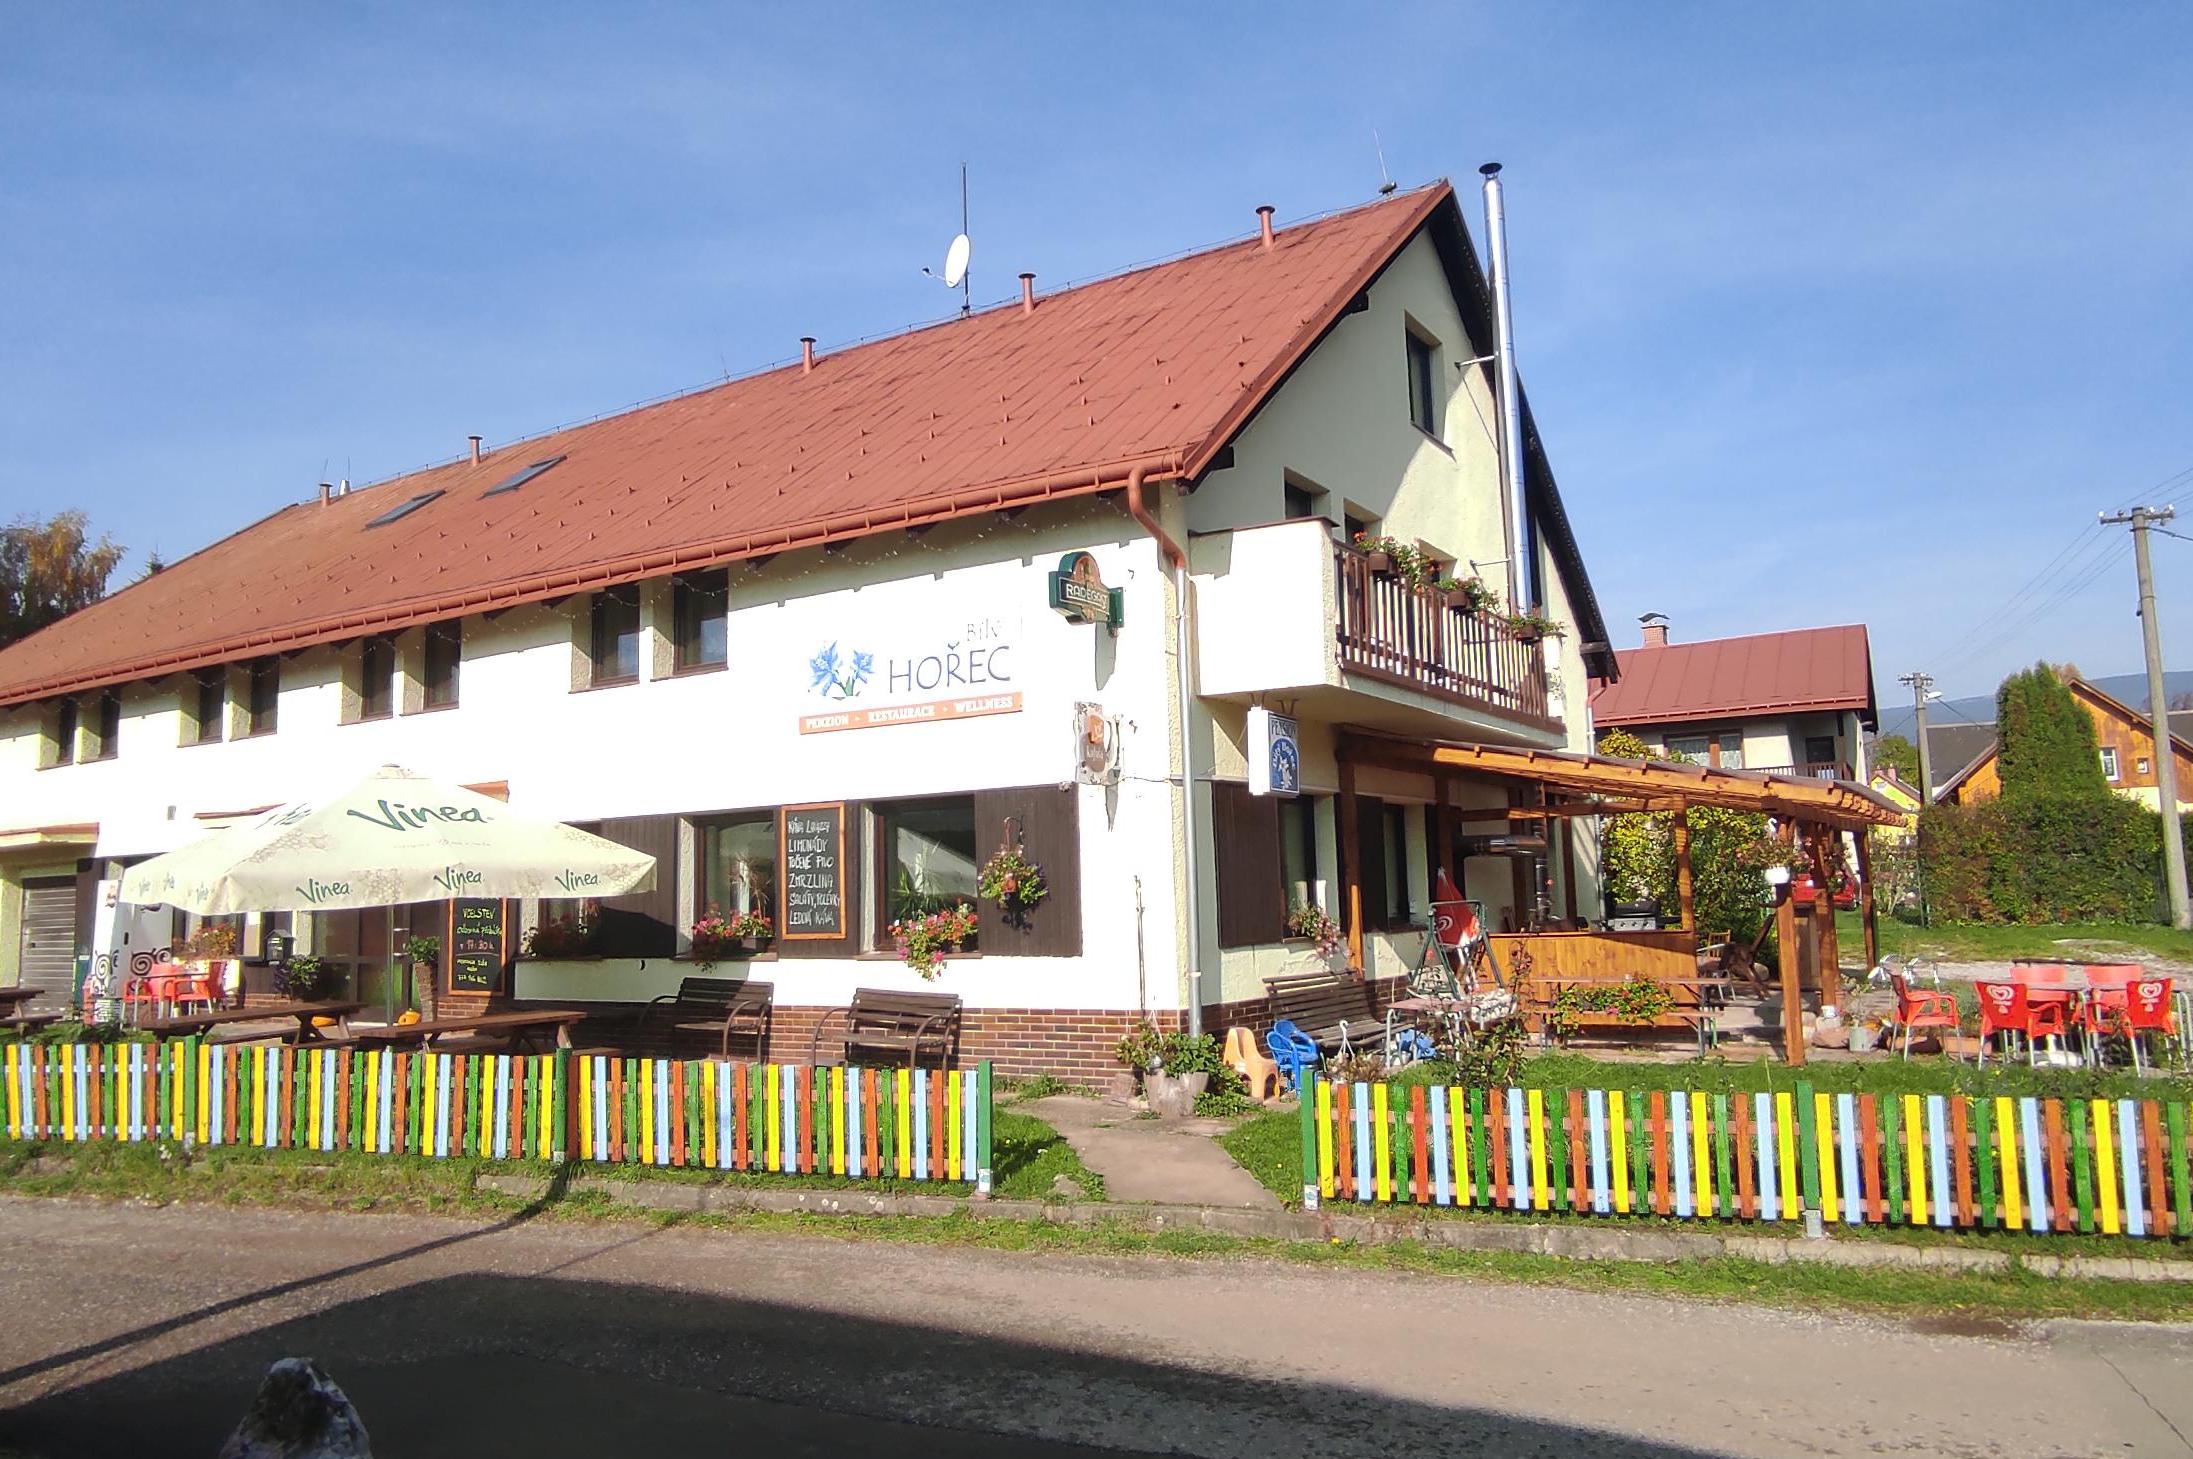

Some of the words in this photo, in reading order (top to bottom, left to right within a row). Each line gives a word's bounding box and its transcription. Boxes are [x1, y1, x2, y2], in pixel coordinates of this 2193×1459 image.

[1066, 583, 1107, 609] RADEGAST
[889, 641, 1011, 694] HOŘEC
[867, 705, 935, 722] RESTAURACE
[954, 695, 1013, 713] WELLNESS
[347, 799, 488, 832] Vinea
[788, 835, 828, 853] LIMONÁDY
[296, 878, 350, 904] Vinea
[433, 866, 482, 891] Vinea
[555, 869, 600, 892] Vinea
[788, 872, 833, 889] ZMRZLINA
